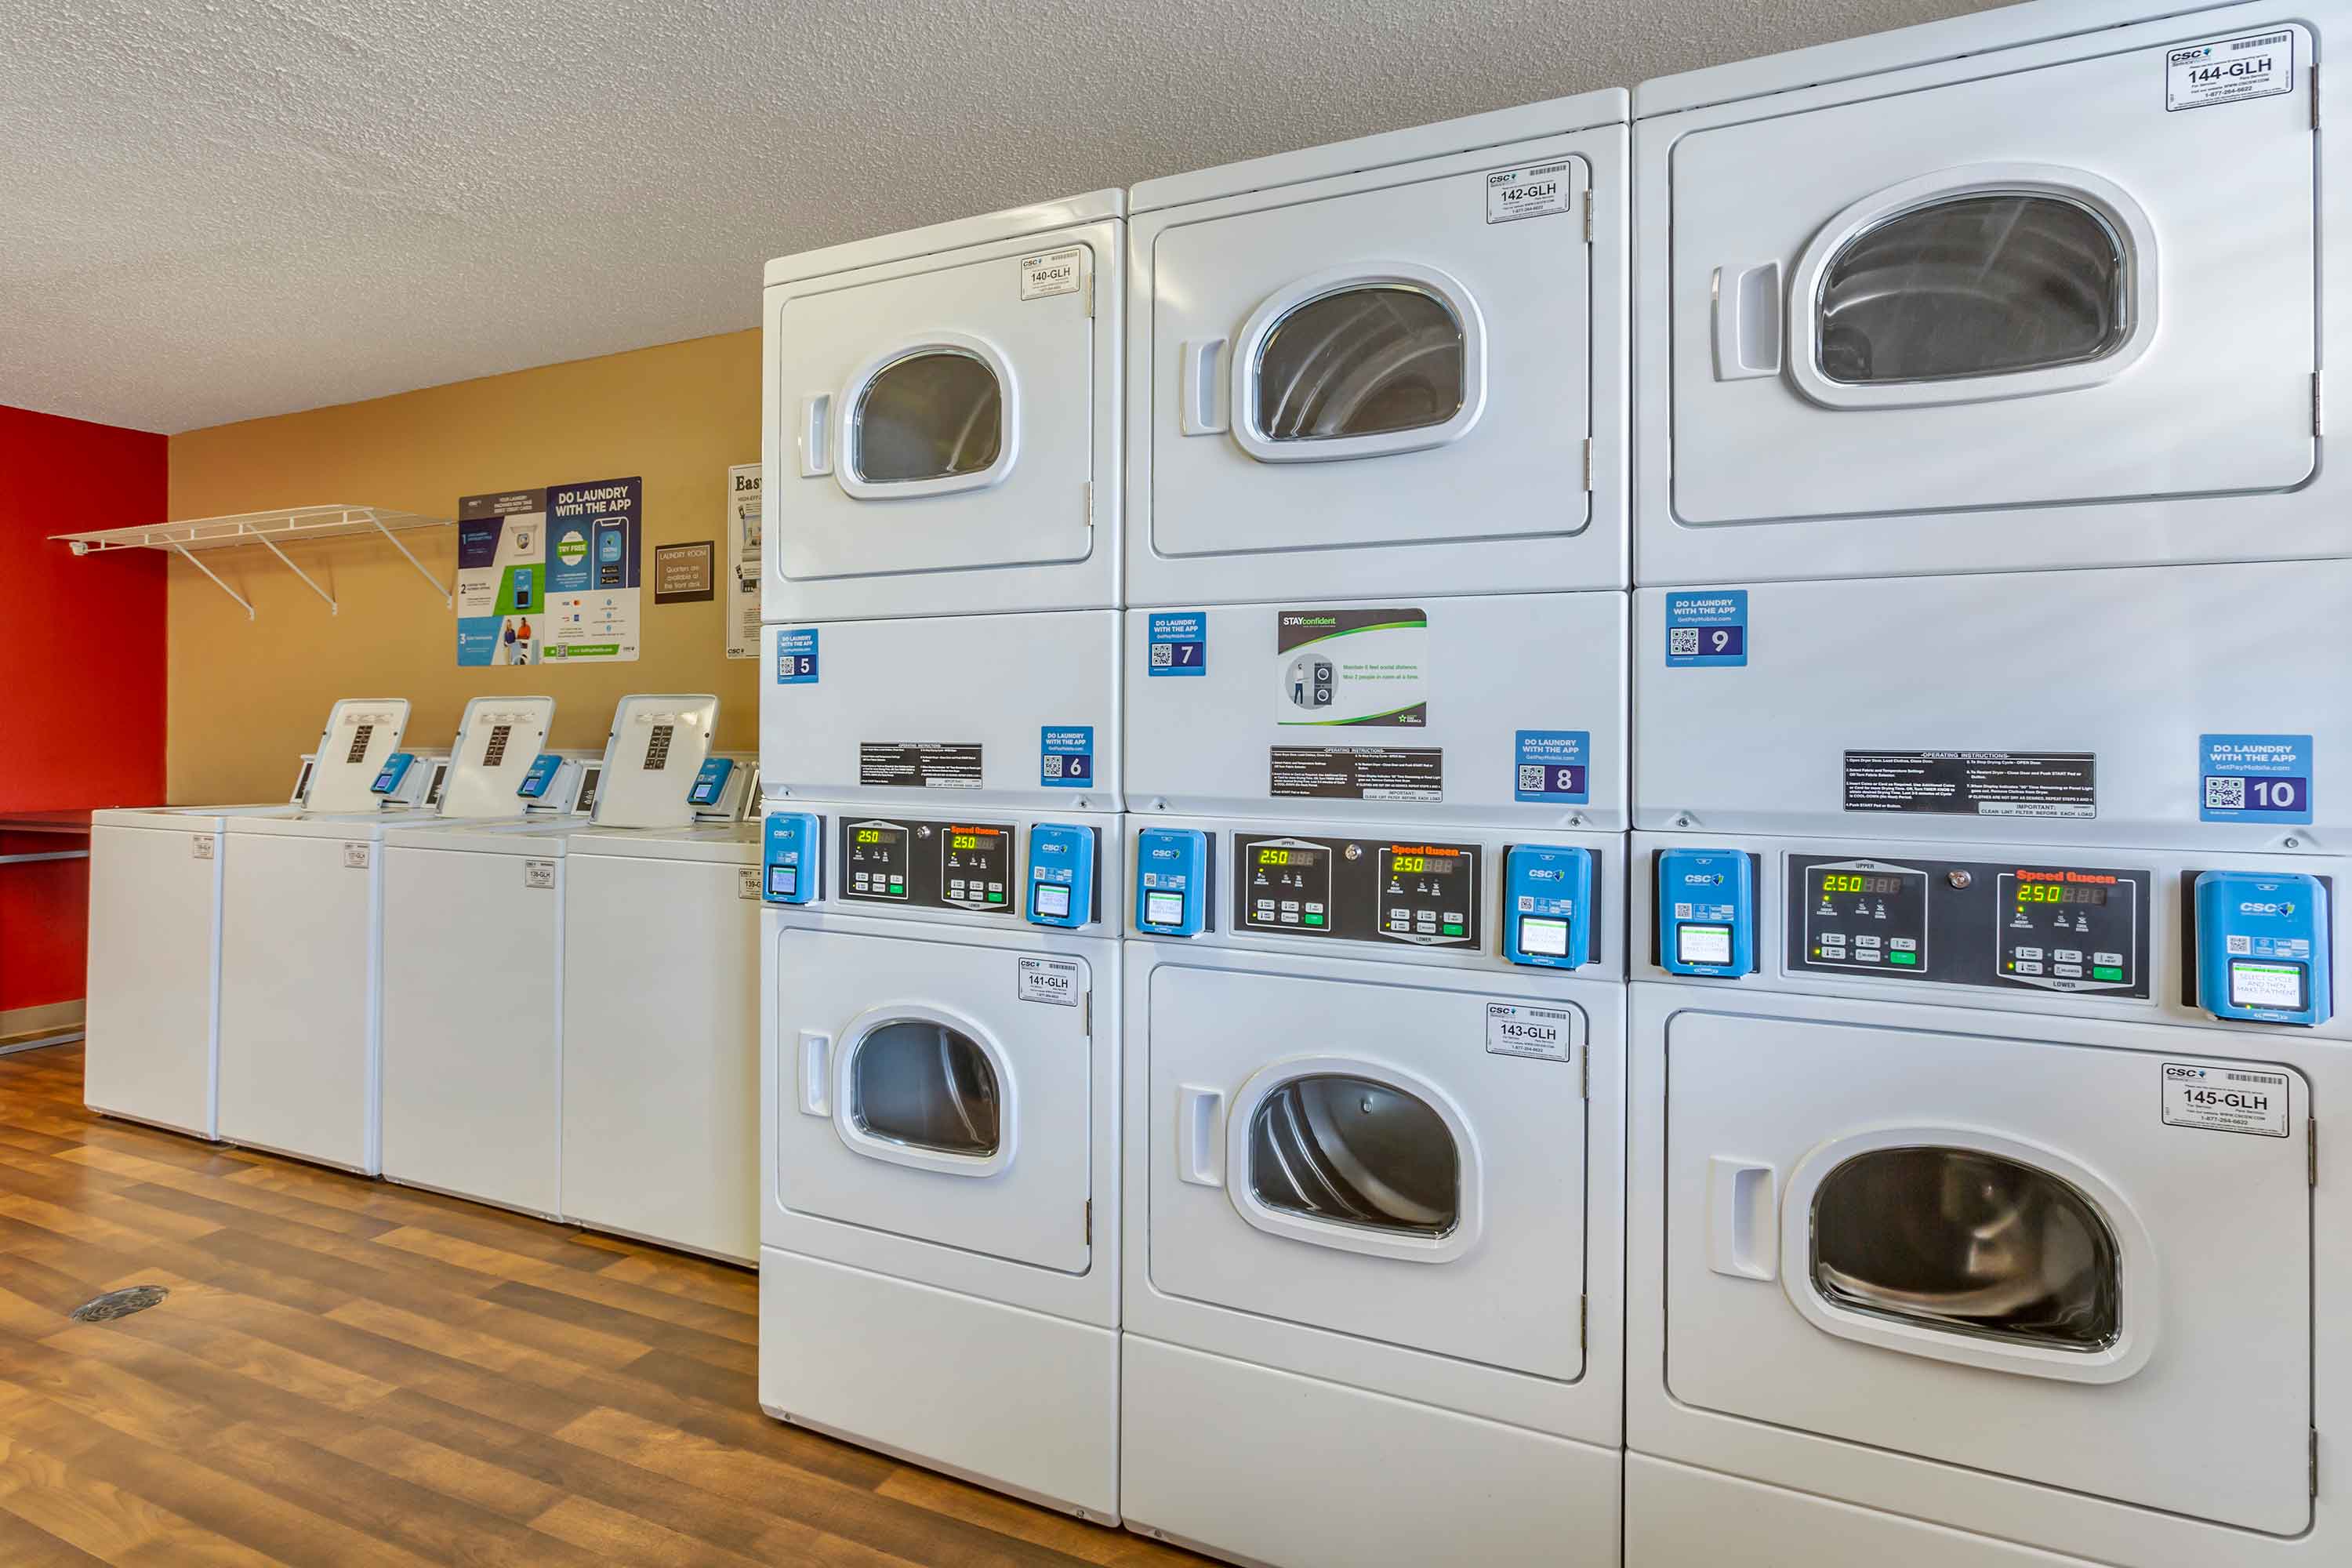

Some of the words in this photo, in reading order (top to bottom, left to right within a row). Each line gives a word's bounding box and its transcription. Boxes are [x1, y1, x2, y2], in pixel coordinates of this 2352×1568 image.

[2171, 50, 2201, 62] CSC
[2188, 58, 2272, 83] 144-GLH
[1490, 174, 1510, 183] CSC
[1501, 183, 1556, 201] 142-GLH
[1031, 267, 1070, 282] 140-GLH
[735, 475, 761, 492] Eas
[558, 492, 575, 504] DO
[576, 486, 629, 503] LAUNDRY
[555, 503, 583, 517] WITH
[586, 502, 606, 514] THE
[608, 499, 632, 512] APP
[659, 551, 684, 560] LAUNDRY
[460, 583, 466, 594] 2
[459, 633, 466, 644] 3
[1711, 630, 1729, 652] 9
[1181, 645, 1193, 664] 7
[800, 658, 810, 673] 5
[1070, 758, 1081, 775] 6
[1557, 769, 1572, 790] 8
[2254, 782, 2295, 808] 10
[1260, 850, 1288, 864] 2.50
[1392, 845, 1424, 855] Speed
[1425, 847, 1459, 856] Queen
[1394, 857, 1424, 872] 2.50
[1823, 876, 1862, 891] 2.50
[2016, 869, 2064, 882] Speed
[2066, 871, 2116, 884] Queen
[2017, 884, 2060, 902] 2.50
[2240, 902, 2278, 912] CSC
[1029, 975, 1068, 989] 141-GLH
[1501, 1024, 1556, 1040] 143-GLH
[2166, 1068, 2196, 1077] CSC
[2183, 1089, 2267, 1110] 145-GLH
